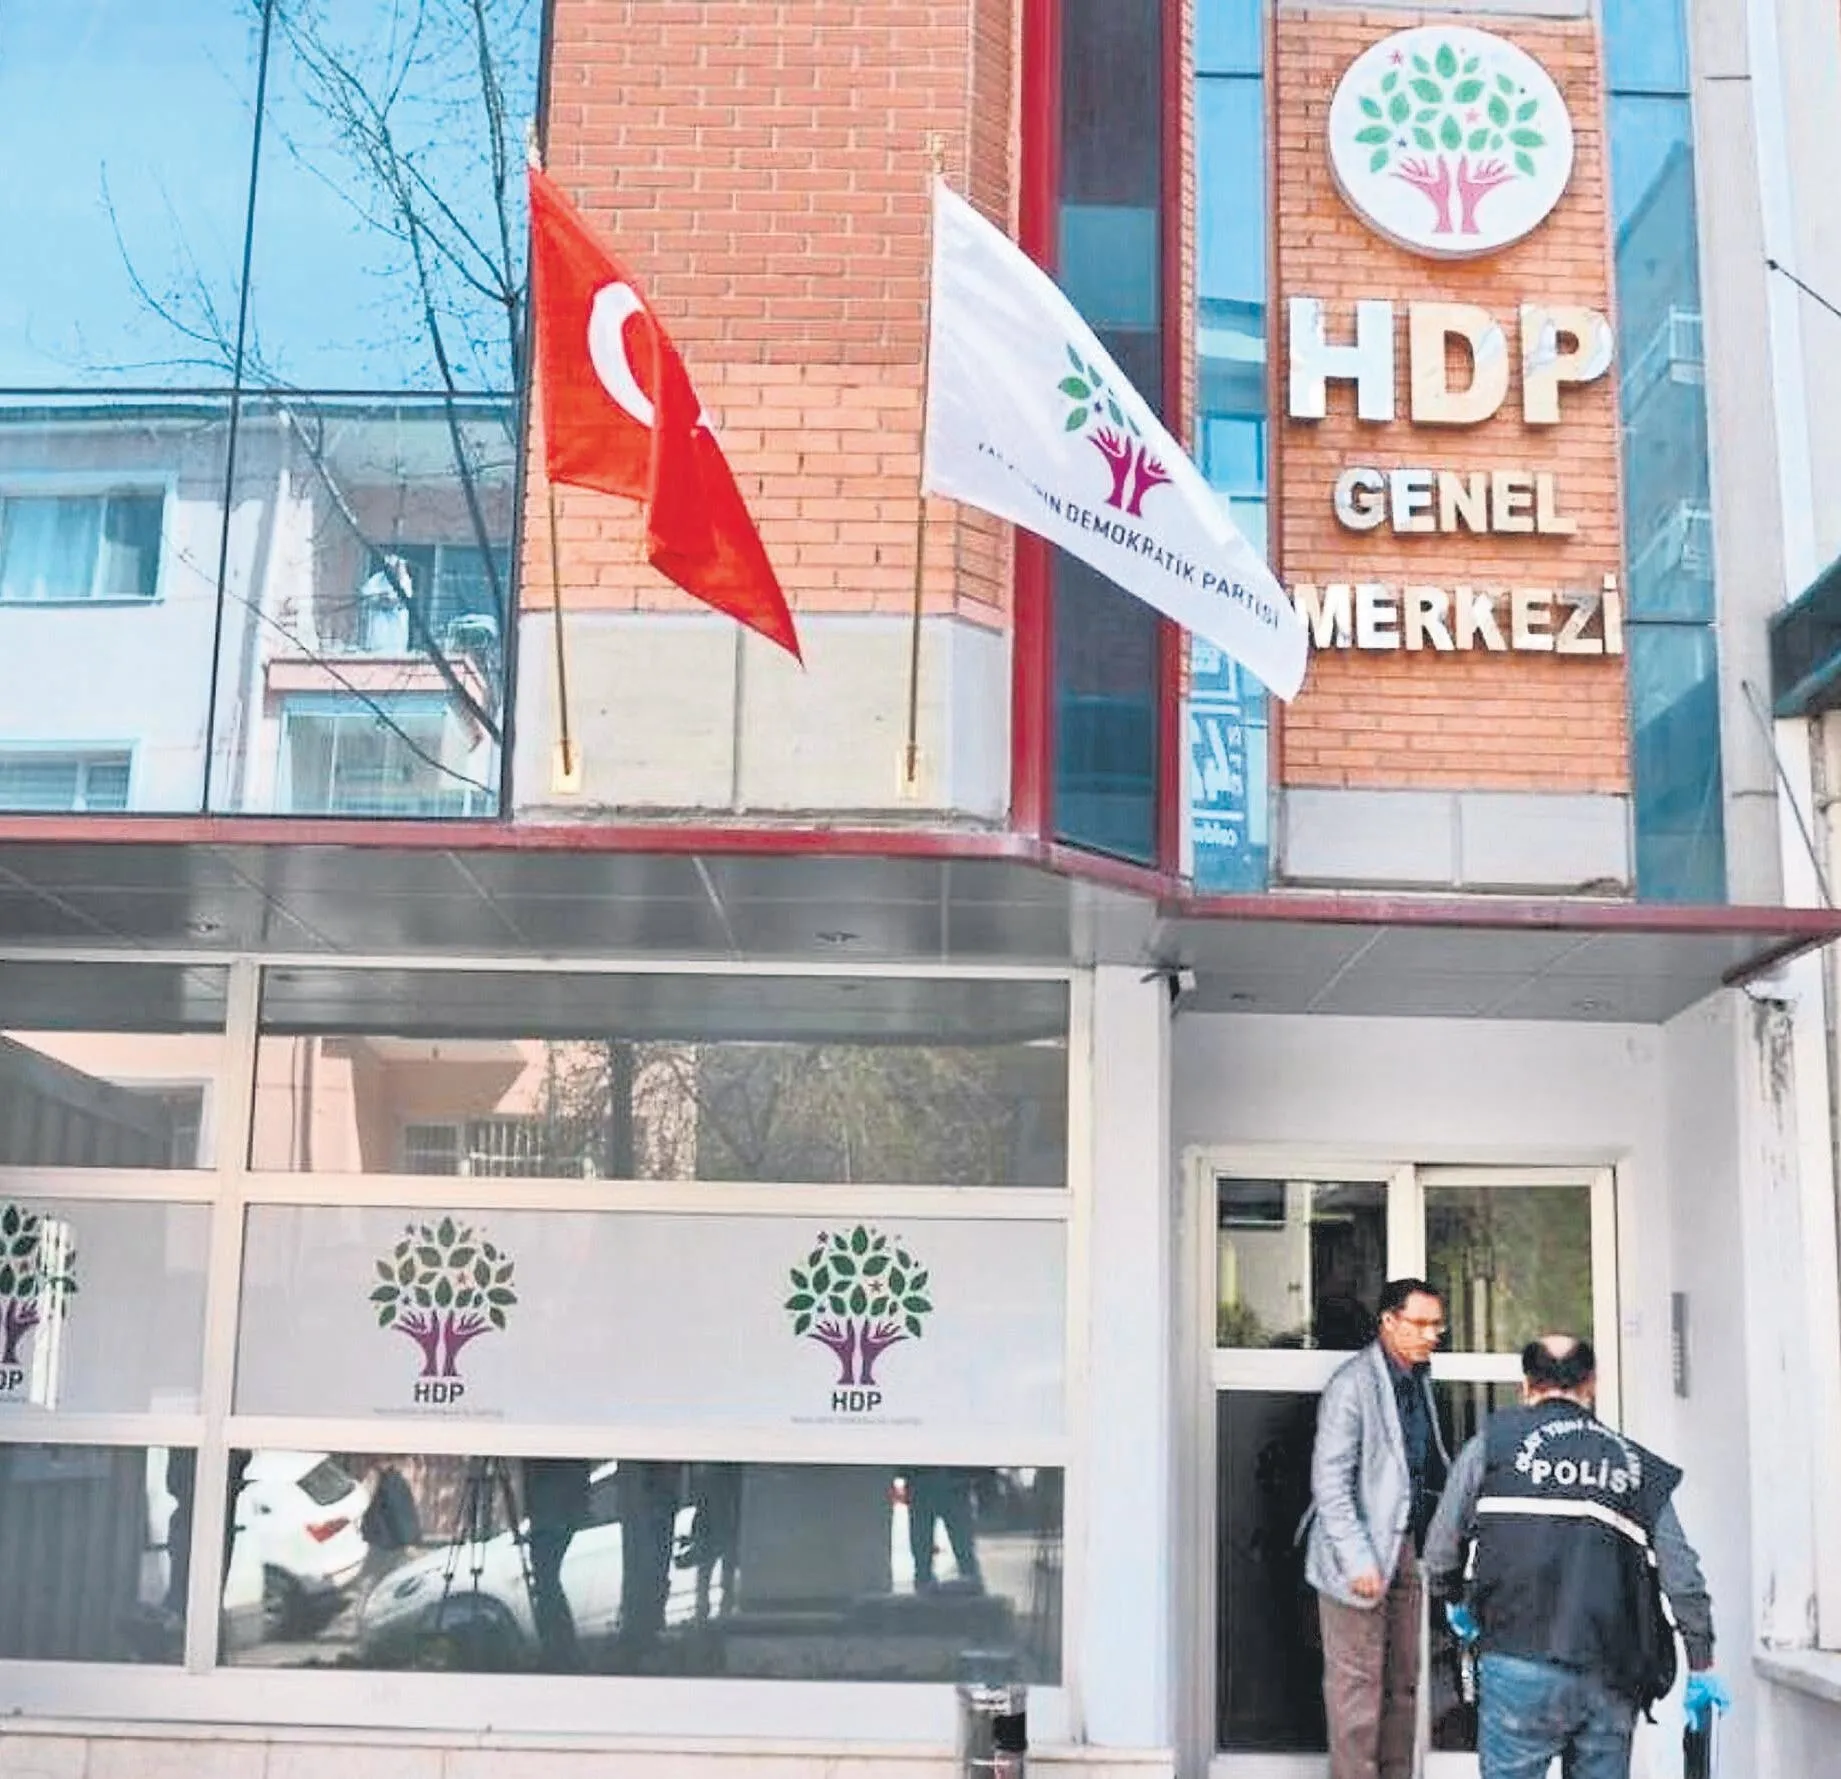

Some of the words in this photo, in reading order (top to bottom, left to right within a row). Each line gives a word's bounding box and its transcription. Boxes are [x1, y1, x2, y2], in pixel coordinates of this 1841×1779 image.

[1288, 297, 1614, 424] HDP
[1334, 467, 1577, 534] GENEL
[1293, 573, 1624, 654] MERKEZİ
[414, 1382, 465, 1403] HDP
[831, 1390, 883, 1412] HDP
